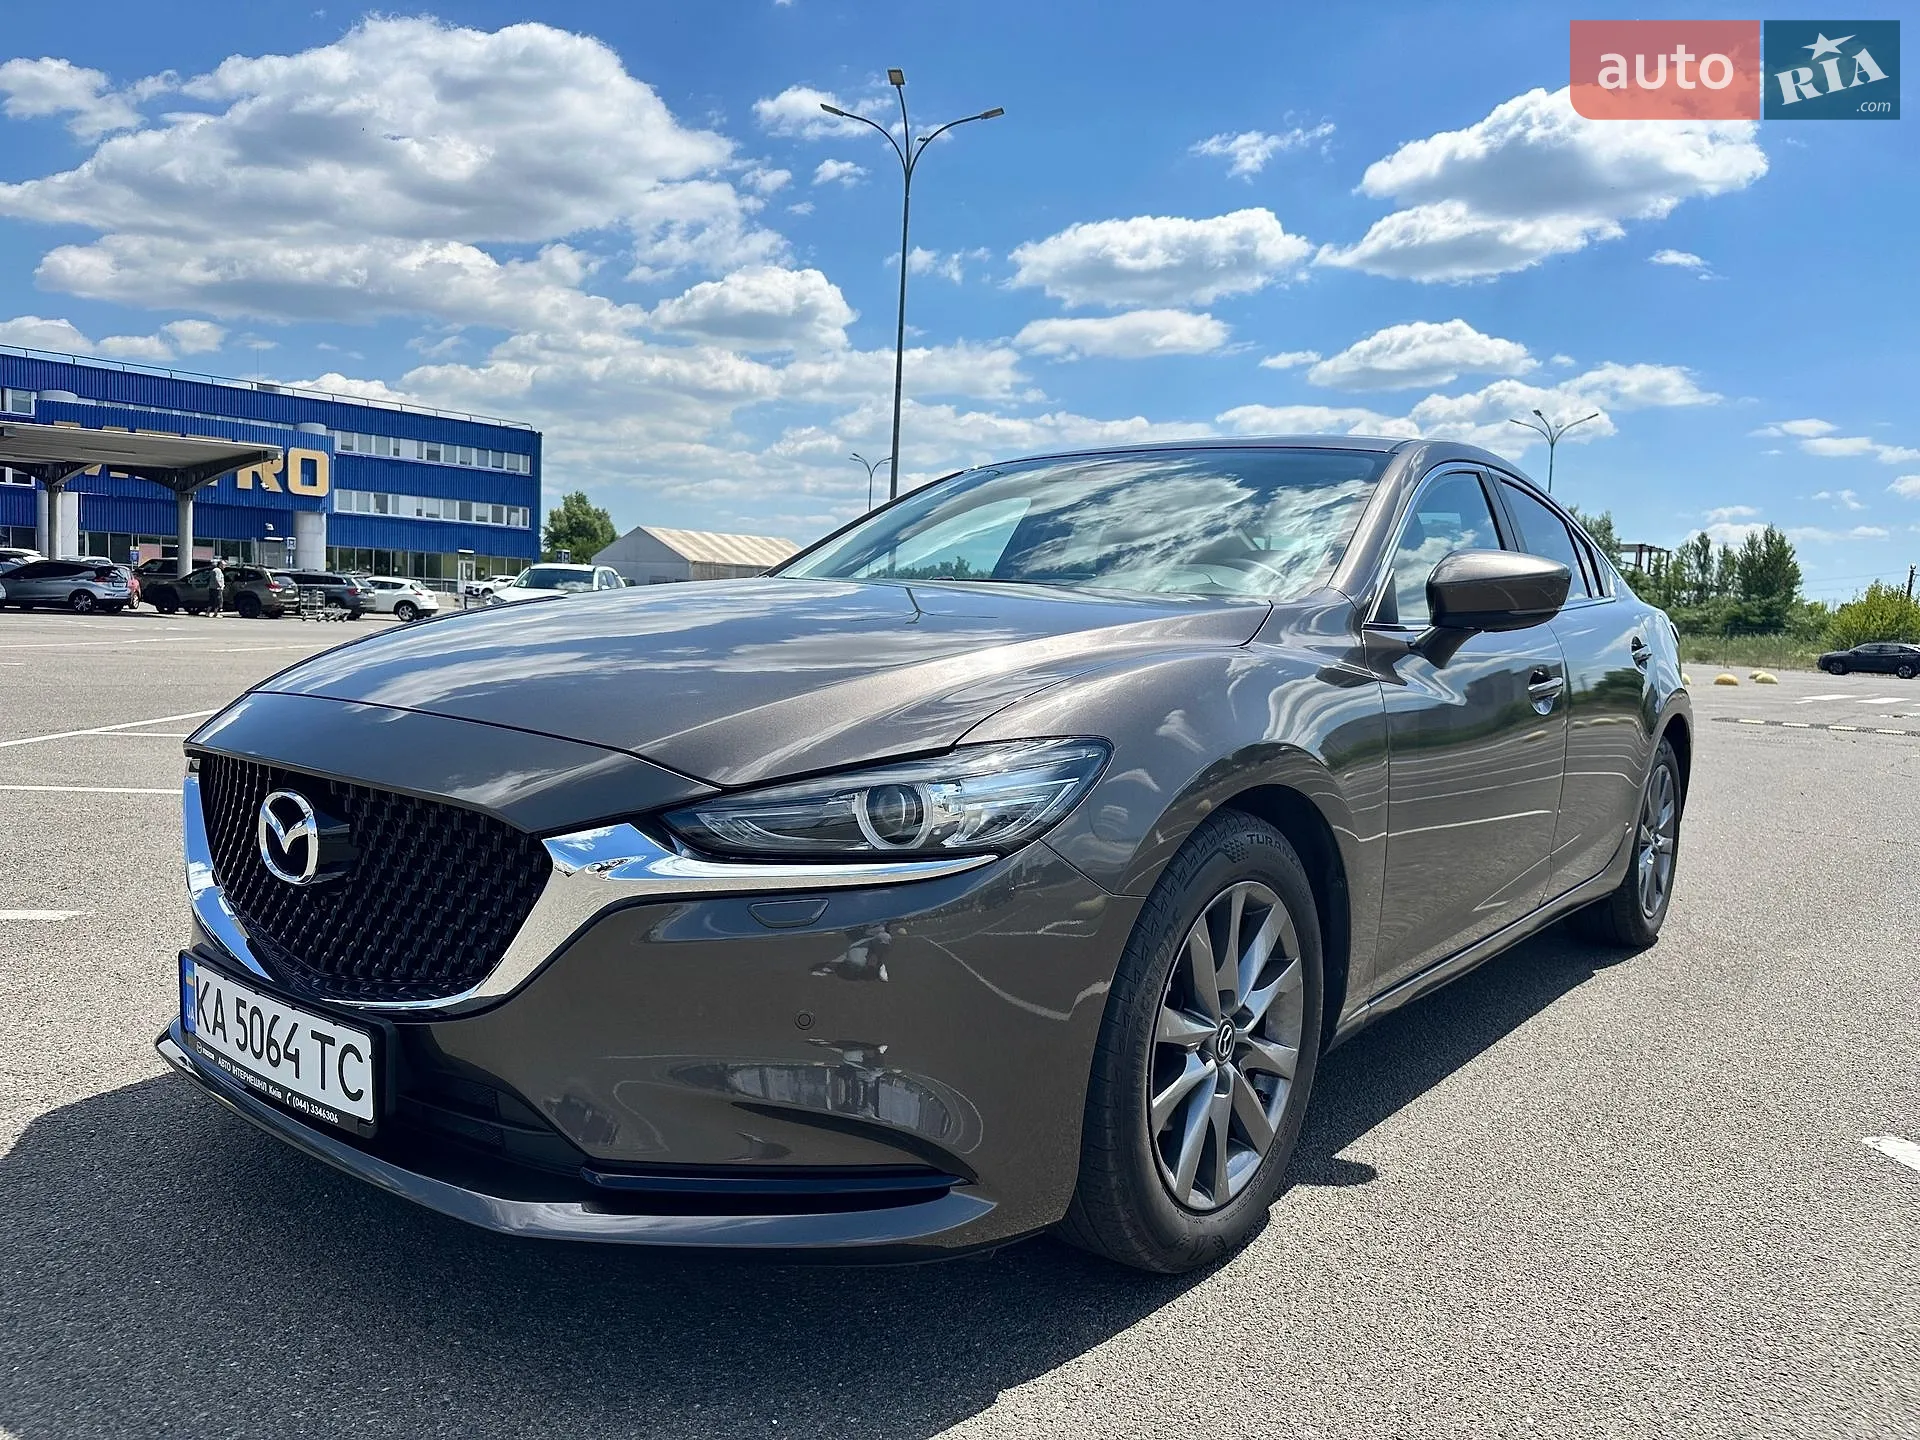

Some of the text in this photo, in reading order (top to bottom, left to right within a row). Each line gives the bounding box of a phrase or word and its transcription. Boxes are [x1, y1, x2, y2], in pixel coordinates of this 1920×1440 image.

[187, 1005, 195, 1021] UA
[195, 975, 364, 1102] KA 5064 TC
